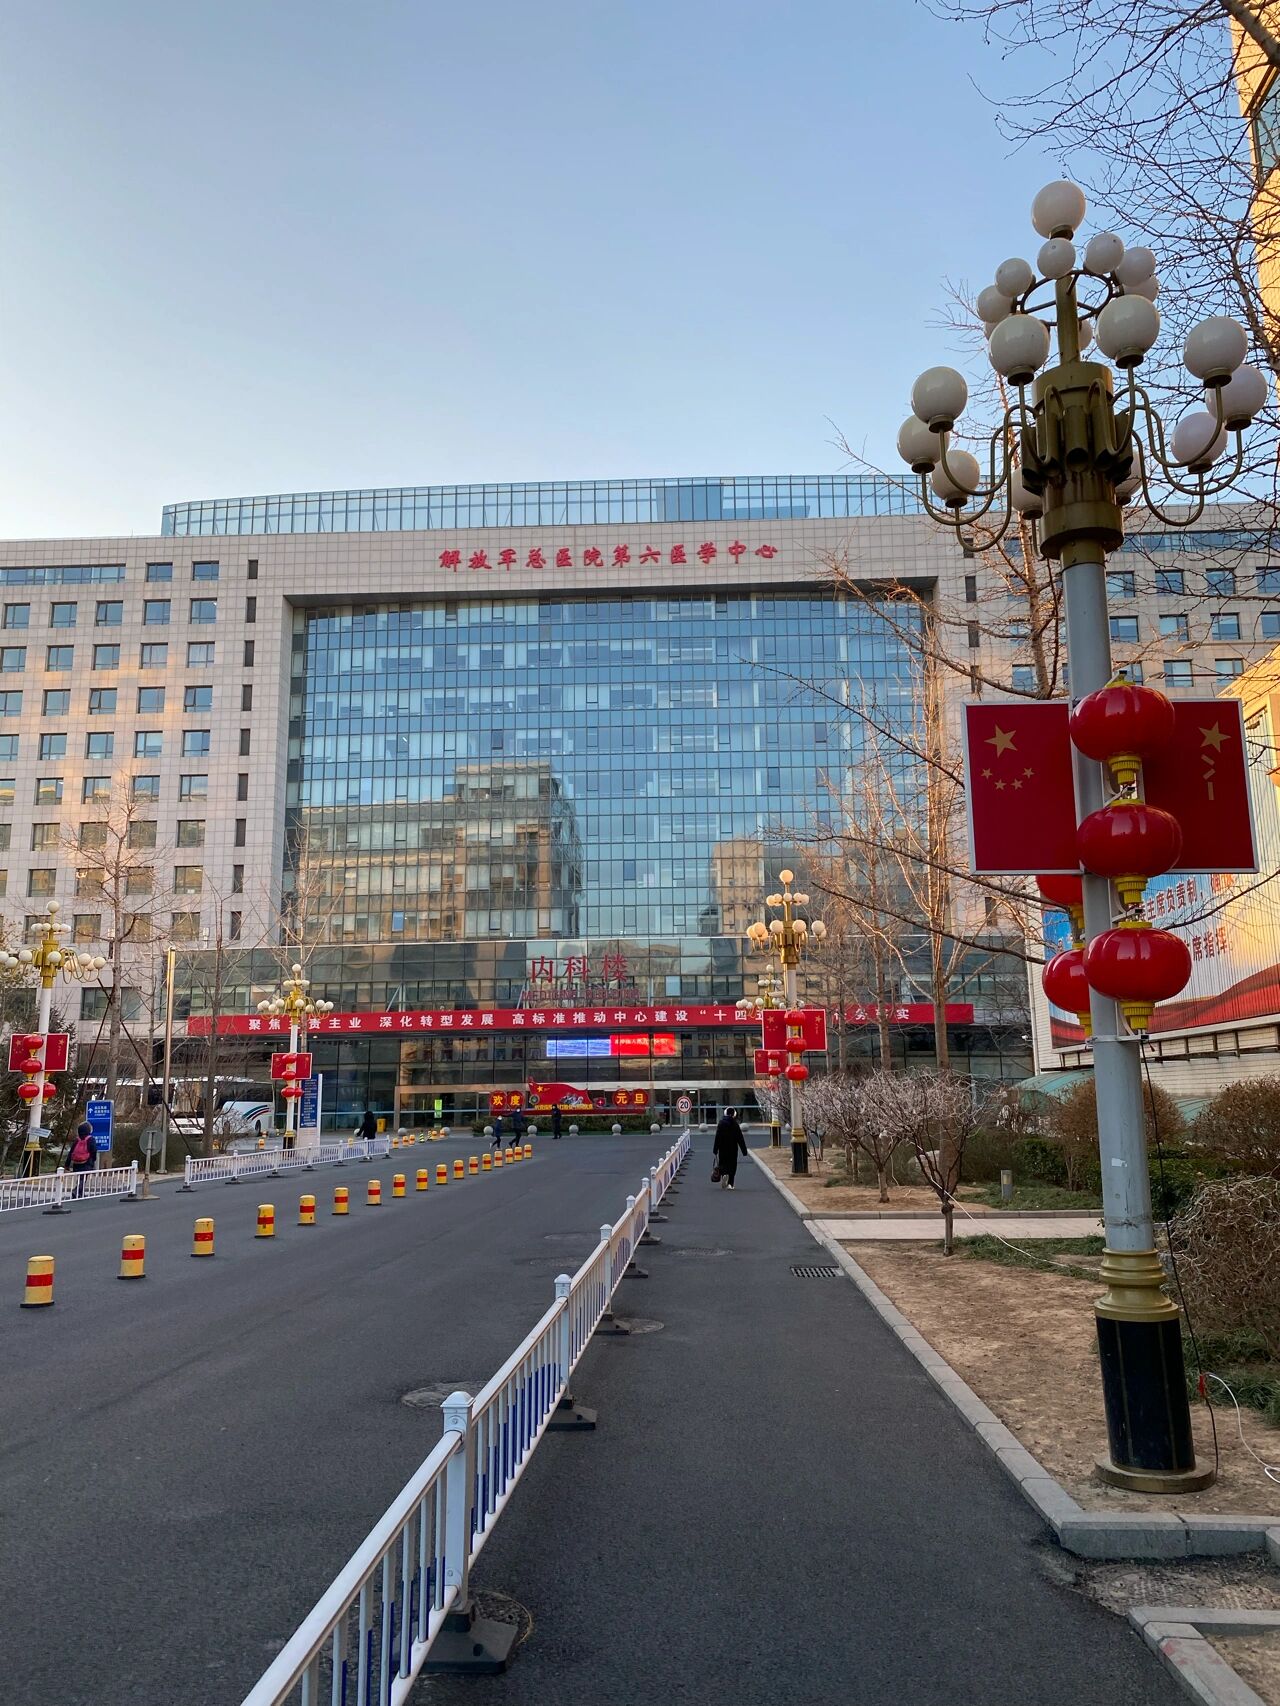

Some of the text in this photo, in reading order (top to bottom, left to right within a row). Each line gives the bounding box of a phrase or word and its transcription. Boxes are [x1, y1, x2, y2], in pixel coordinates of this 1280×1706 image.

[438, 541, 778, 572] 解放军总医院第六医学中心
[1185, 926, 1228, 961] 席指挥
[531, 954, 628, 983] 内科楼
[379, 1013, 494, 1028] 深化转型发展
[492, 1093, 645, 1106] 欢度 元旦
[680, 1101, 689, 1109] 20
